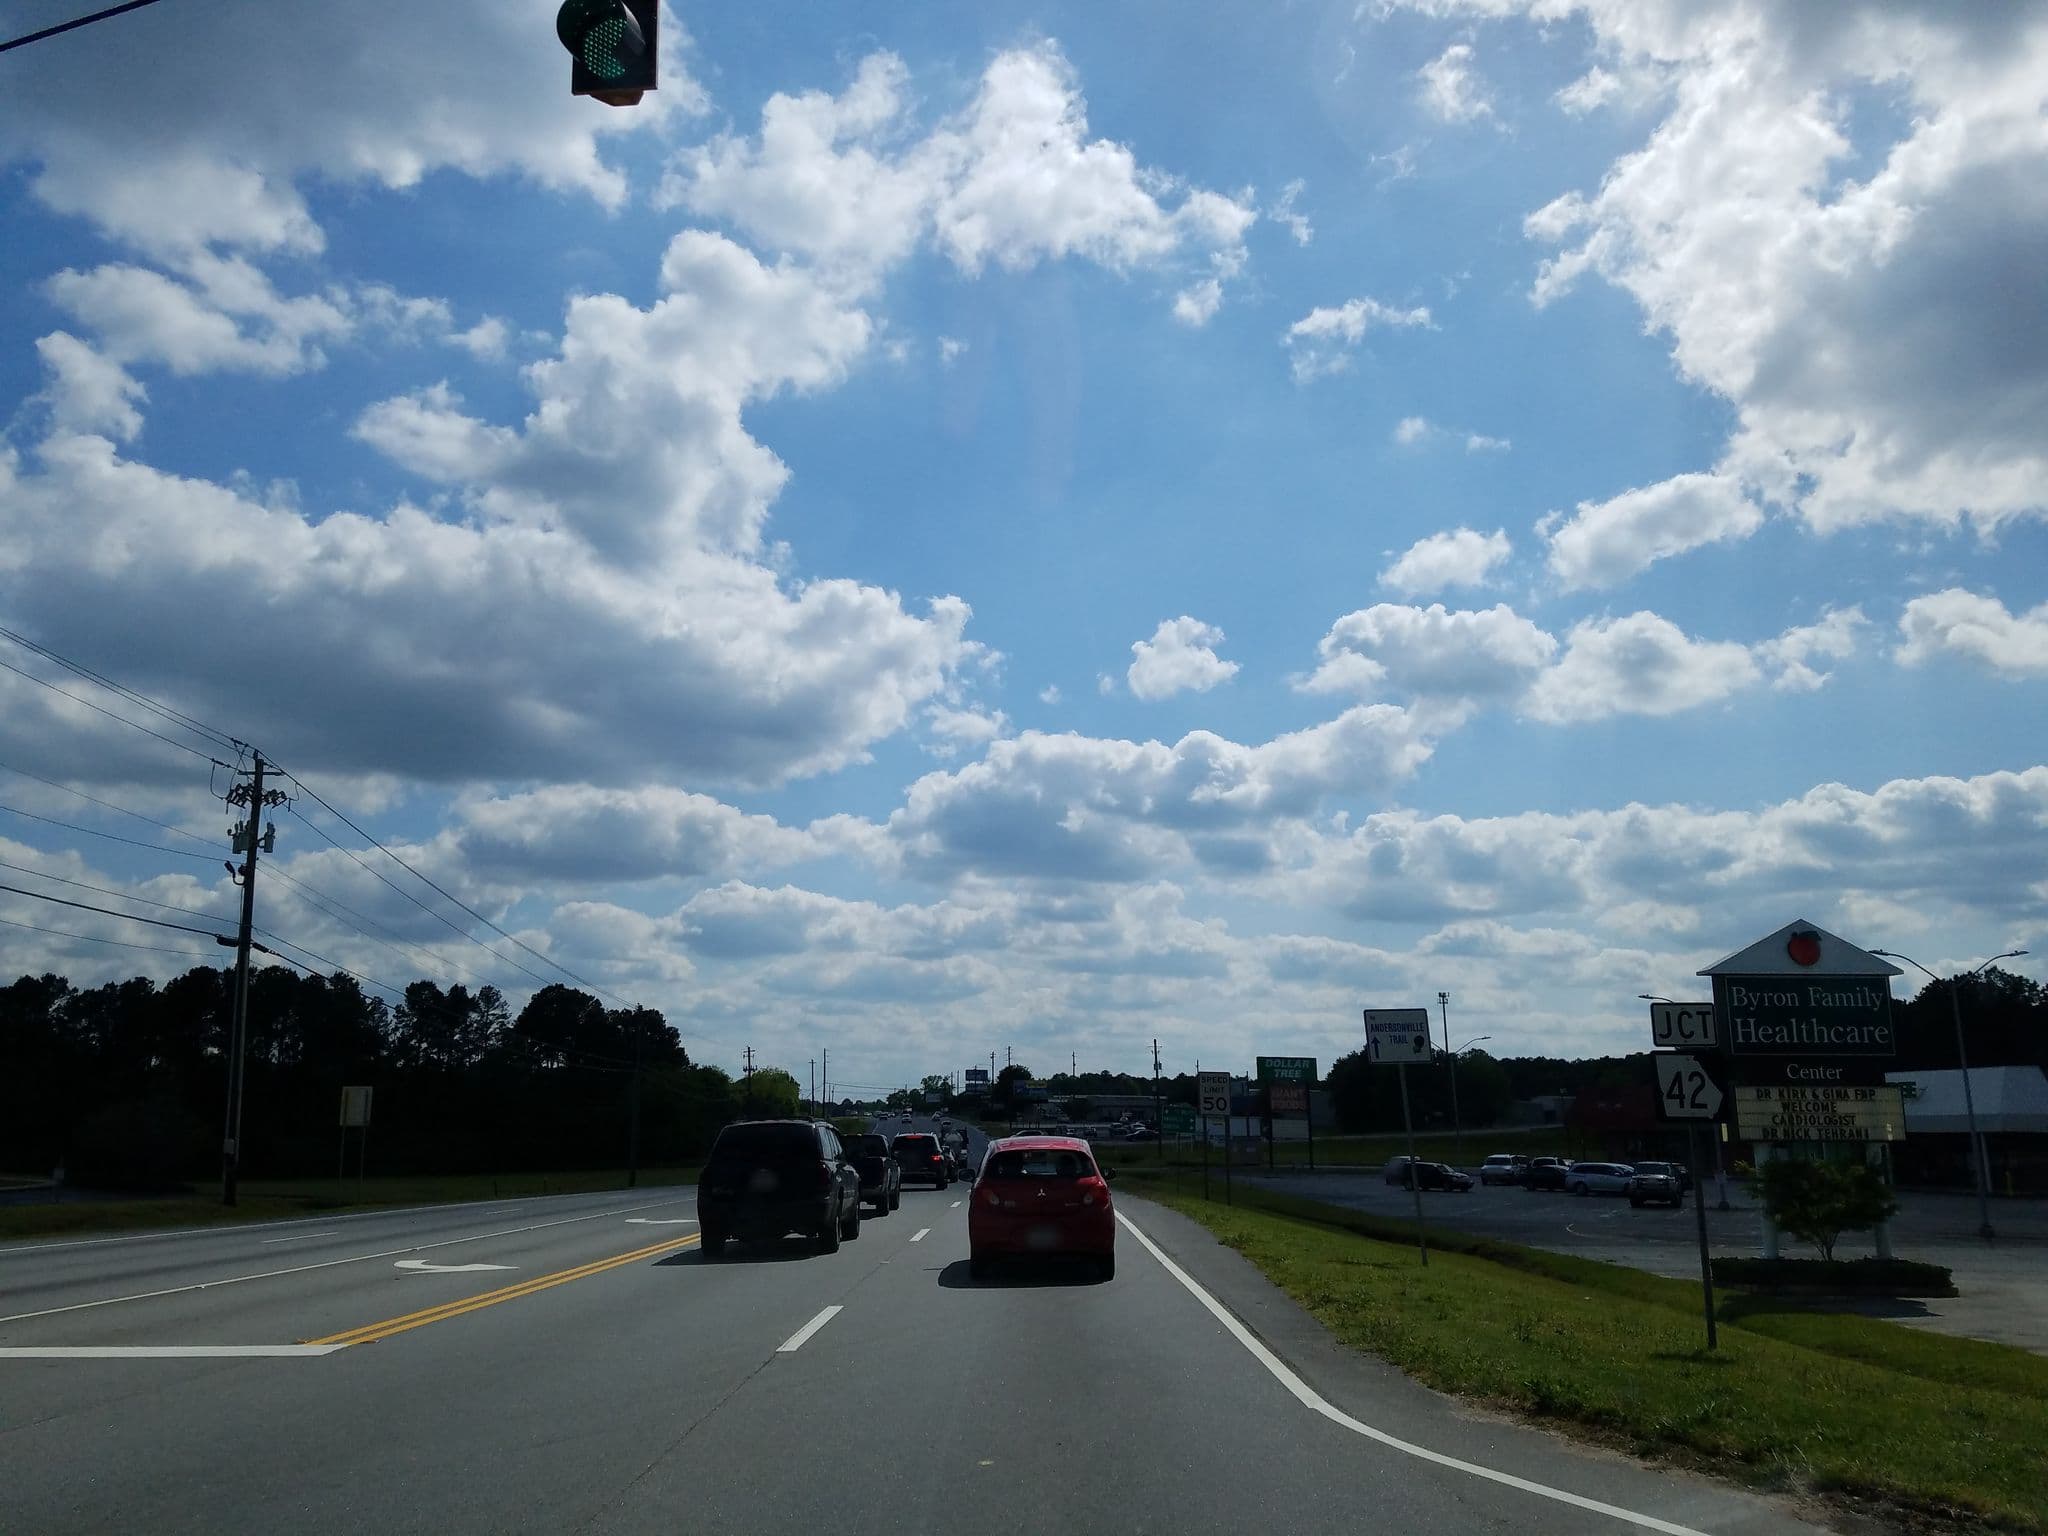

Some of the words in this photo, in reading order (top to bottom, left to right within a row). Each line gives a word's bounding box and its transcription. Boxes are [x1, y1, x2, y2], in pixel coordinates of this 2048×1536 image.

[1731, 986, 1800, 1010] Byron
[1808, 986, 1883, 1011] Family
[1370, 1022, 1425, 1032] ANDERSONVILLE
[1659, 1011, 1711, 1039] JCT
[1735, 1018, 1889, 1044] Healthcare
[1390, 1035, 1408, 1044] TRAIL
[1265, 1058, 1310, 1068] DOLLAR
[1273, 1069, 1302, 1078] TREE
[1786, 1063, 1843, 1080] Center
[1667, 1070, 1707, 1109] 42
[1757, 1088, 1771, 1099] DR
[1778, 1088, 1807, 1099] KIRK
[1823, 1088, 1850, 1099] GINA
[1855, 1088, 1876, 1099] FNP
[1203, 1097, 1227, 1111] 50
[1782, 1101, 1837, 1113] WELCOME
[1772, 1114, 1856, 1126] CARDIOLOGIST
[1762, 1127, 1778, 1139] DR
[1784, 1127, 1810, 1139] NICK
[1817, 1127, 1869, 1139] TEHRANI
